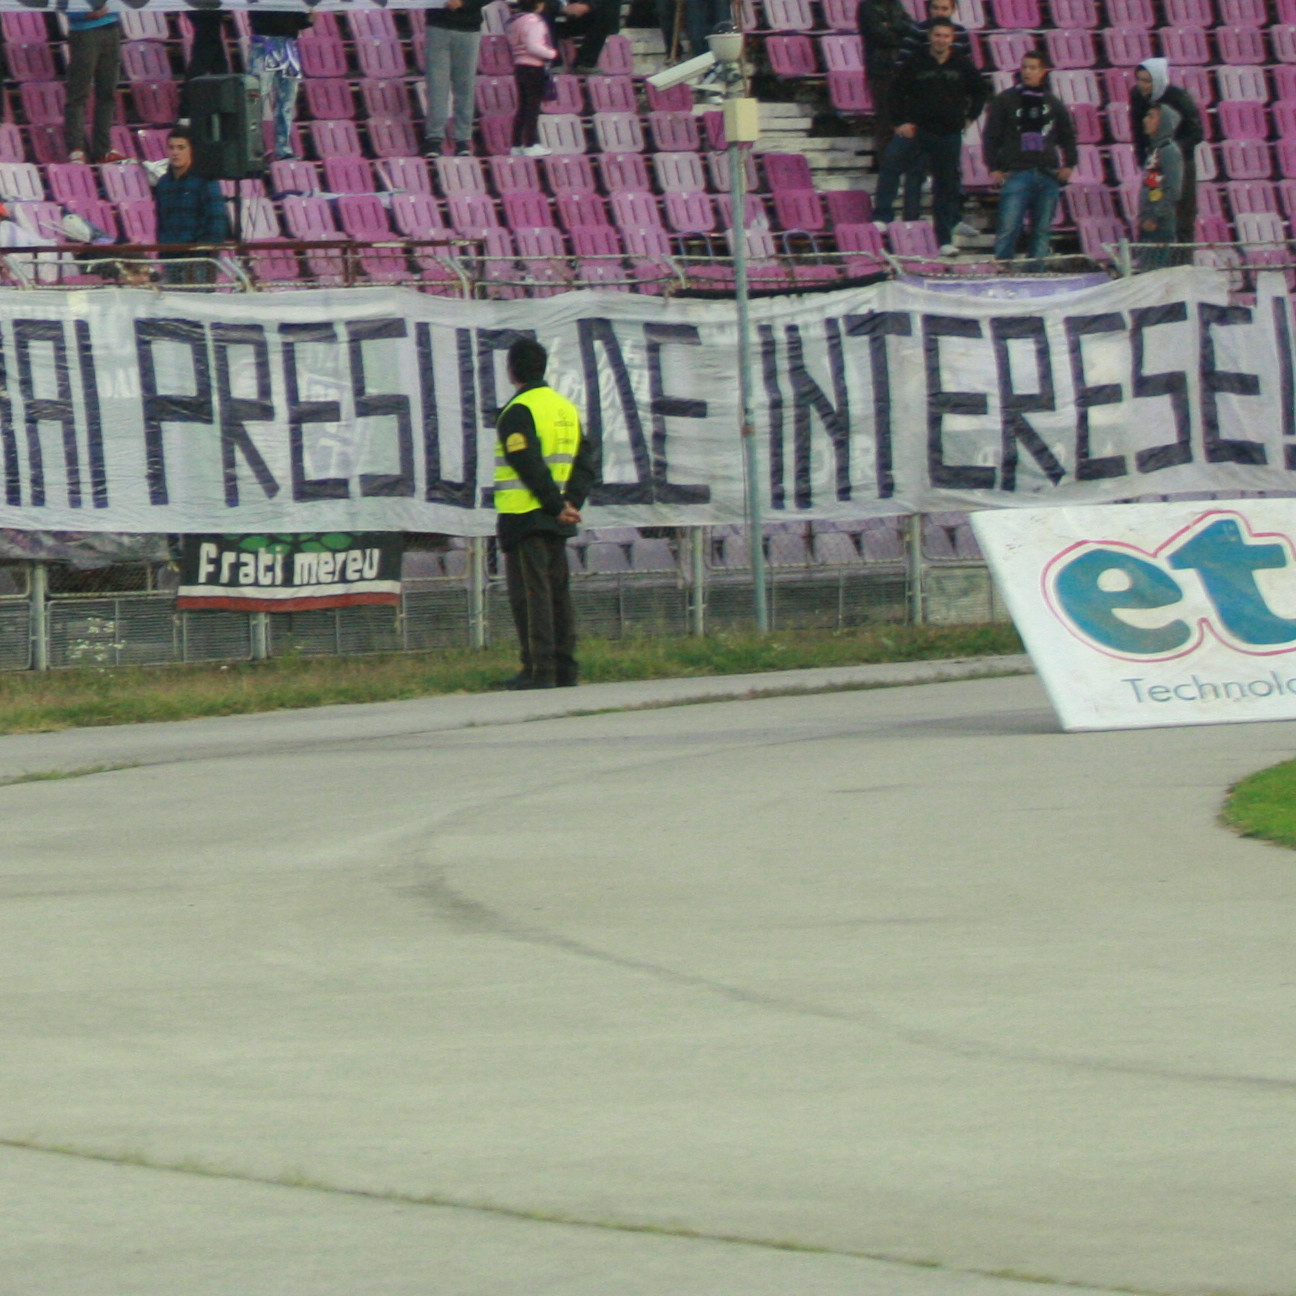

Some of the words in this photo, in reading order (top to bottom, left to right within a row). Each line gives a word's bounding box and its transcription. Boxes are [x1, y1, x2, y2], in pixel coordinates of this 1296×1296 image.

[577, 317, 711, 505] DE
[757, 296, 1296, 510] INTERESE!
[293, 548, 380, 586] mereu
